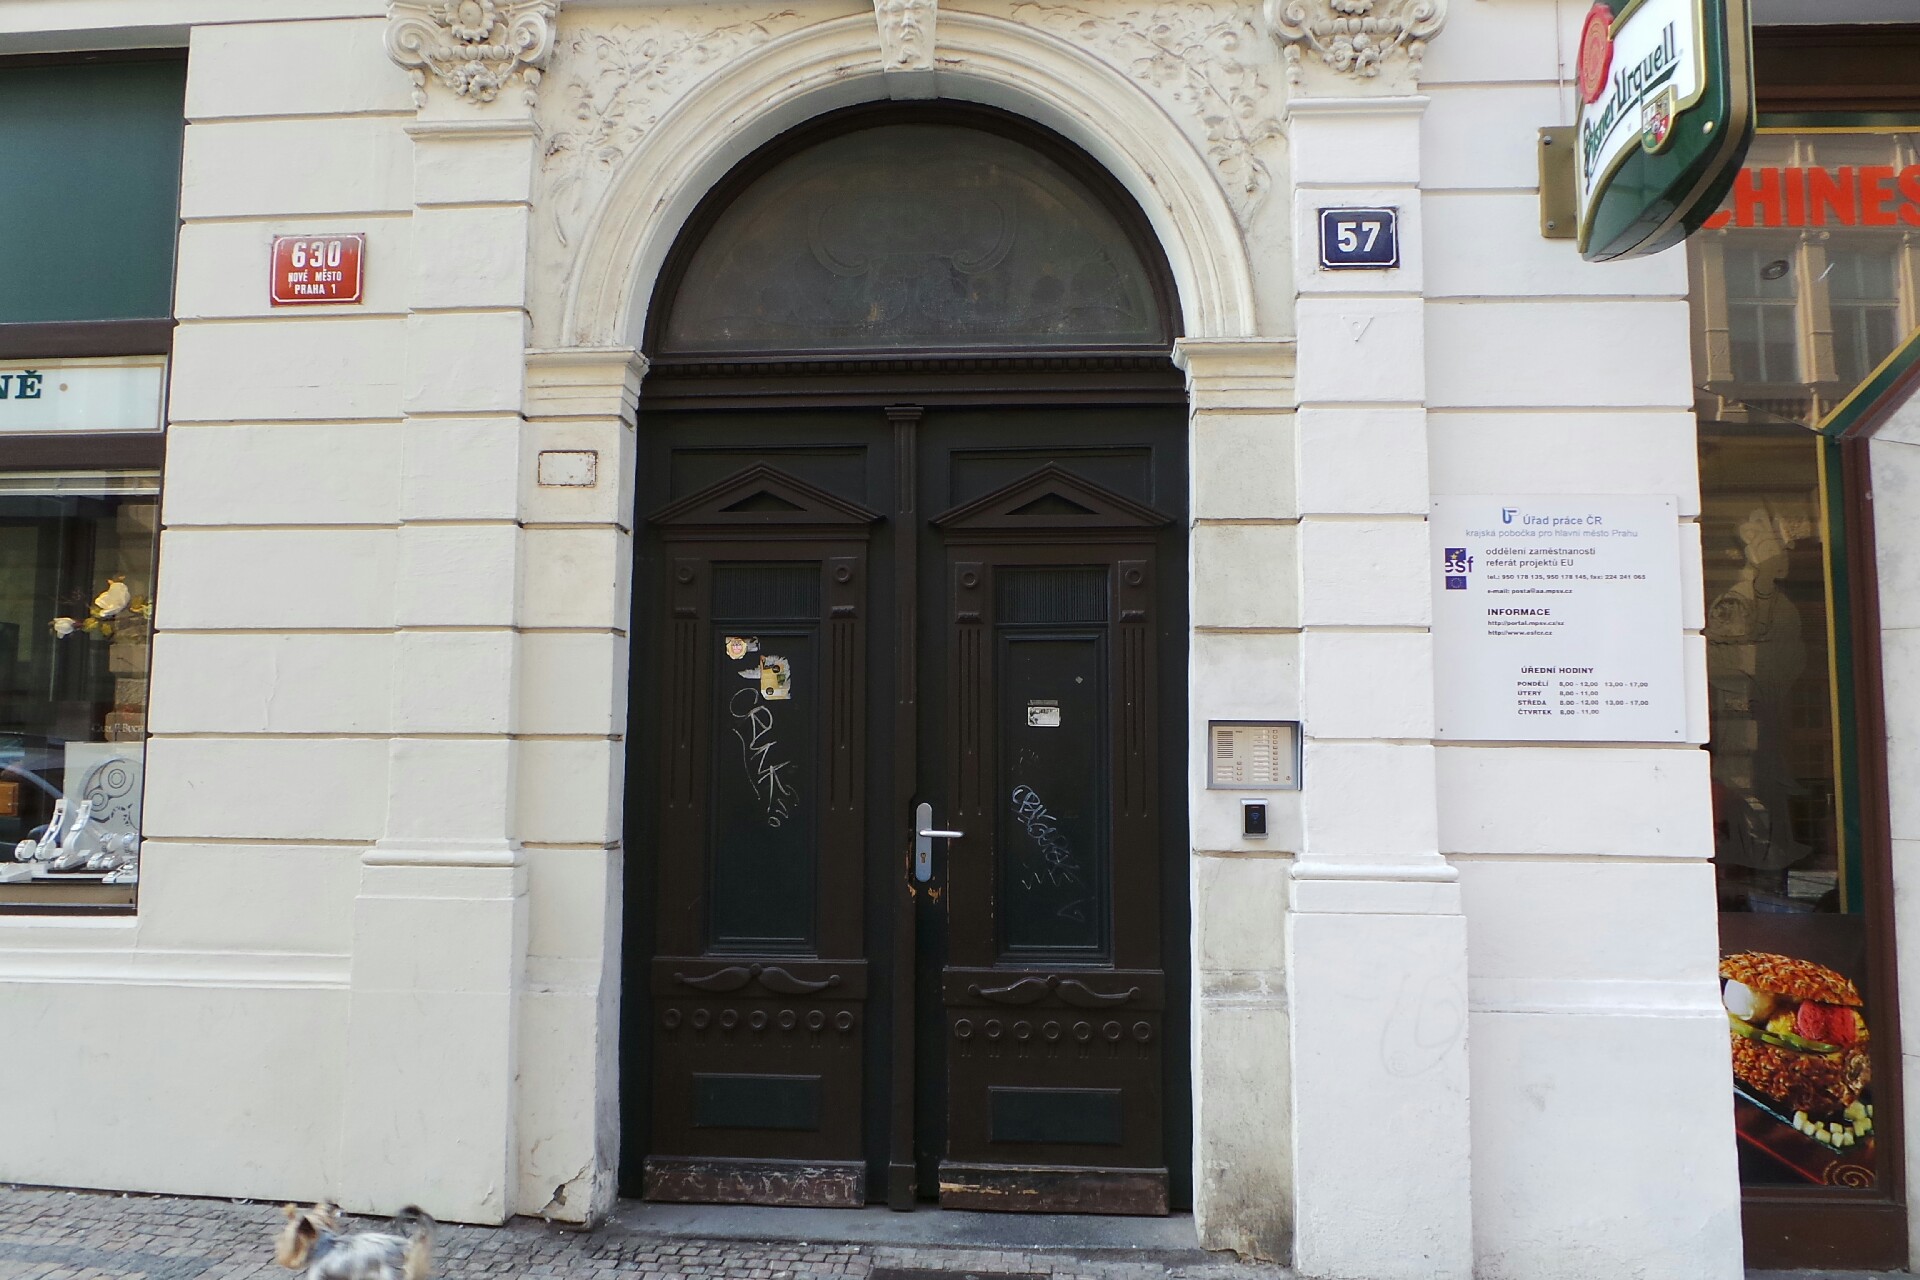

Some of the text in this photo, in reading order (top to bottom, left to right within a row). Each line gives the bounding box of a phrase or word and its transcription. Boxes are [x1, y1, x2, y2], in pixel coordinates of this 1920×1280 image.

[1584, 20, 1675, 196] Pilsner Urquell
[1701, 166, 1920, 229] HINES
[1337, 221, 1381, 253] 57
[291, 240, 342, 268] 630
[287, 268, 342, 283] NOVÉ MĚSTO
[294, 284, 336, 295] PRAHA 1
[1523, 513, 1603, 527] Úřad práce ČR
[1466, 529, 1638, 539] krajská pobočka pro hlavní město Prahu
[1485, 547, 1596, 555] oddělení zaměstnanosti
[1444, 555, 1474, 573] esf
[1486, 558, 1574, 568] referát projektů EU
[1487, 608, 1551, 616] INFORMACE
[1521, 665, 1556, 674] ÚŘEDNÍ
